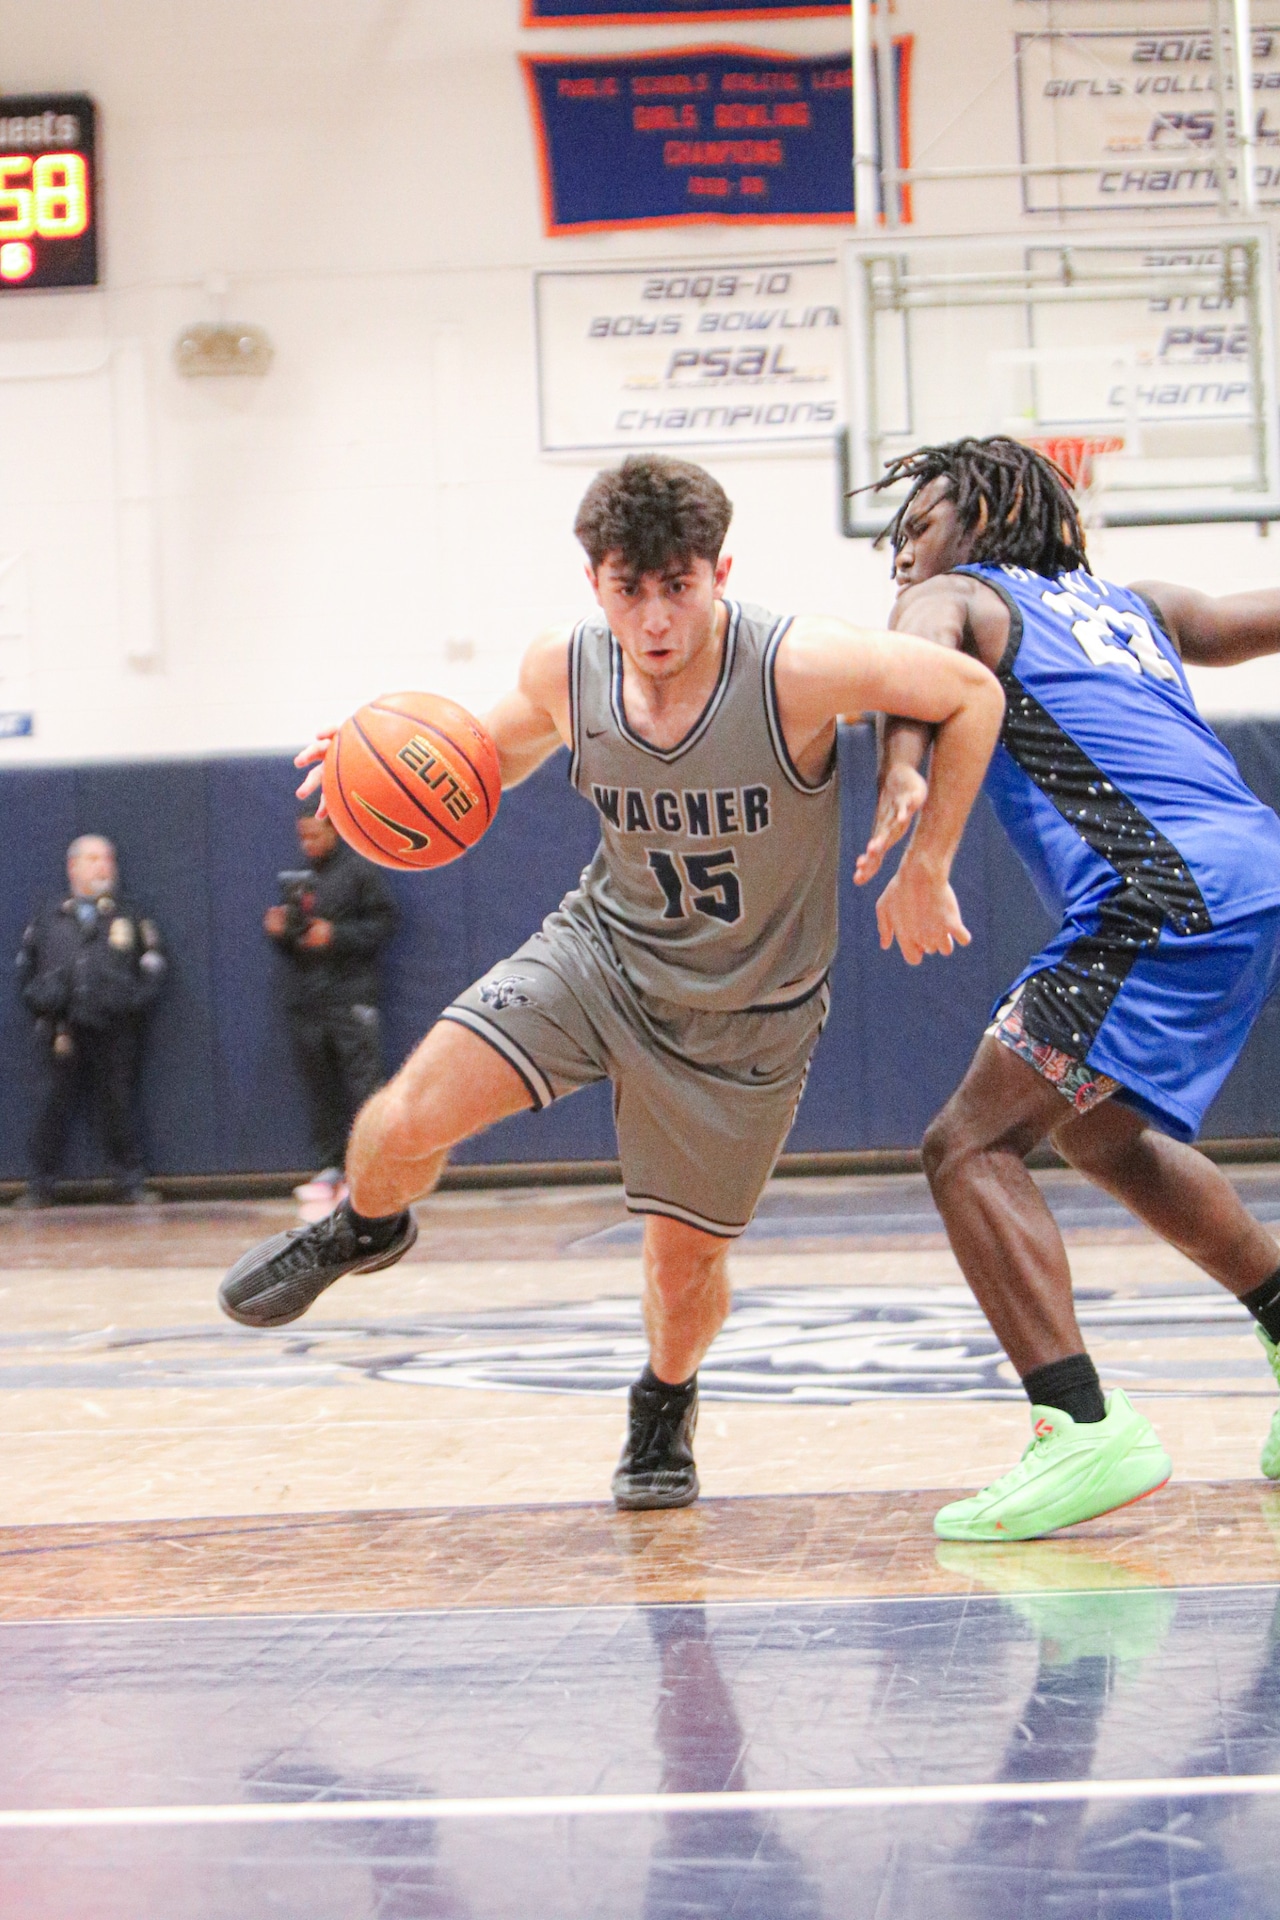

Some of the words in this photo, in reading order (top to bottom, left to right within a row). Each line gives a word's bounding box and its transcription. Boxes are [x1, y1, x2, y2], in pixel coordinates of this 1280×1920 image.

[0, 153, 88, 239] 58
[396, 738, 474, 822] ELITE
[590, 782, 771, 838] WAGNER
[644, 846, 744, 928] 15
